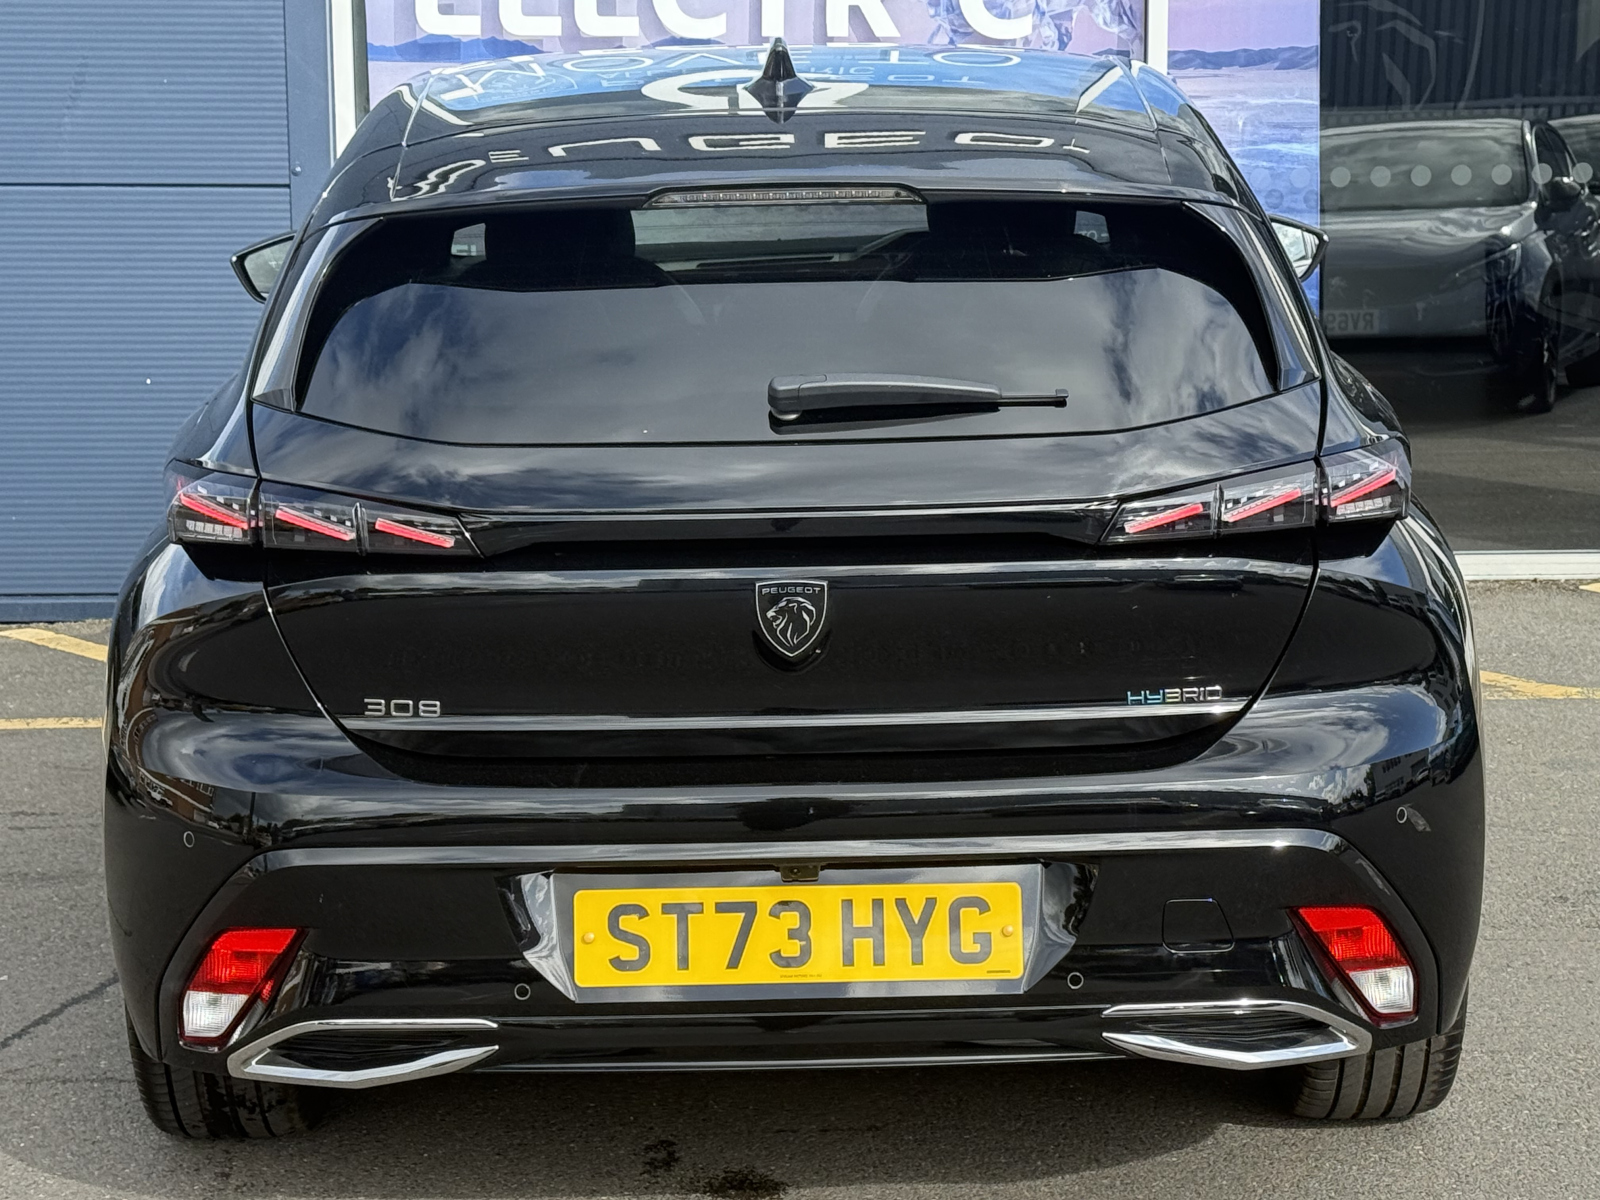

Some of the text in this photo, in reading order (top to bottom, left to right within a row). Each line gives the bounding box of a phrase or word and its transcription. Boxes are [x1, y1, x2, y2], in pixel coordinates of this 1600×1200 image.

[761, 586, 821, 595] PEUGEOT
[1126, 685, 1222, 705] HYBRID
[364, 698, 441, 717] 308
[607, 896, 992, 972] ST73 HYG
